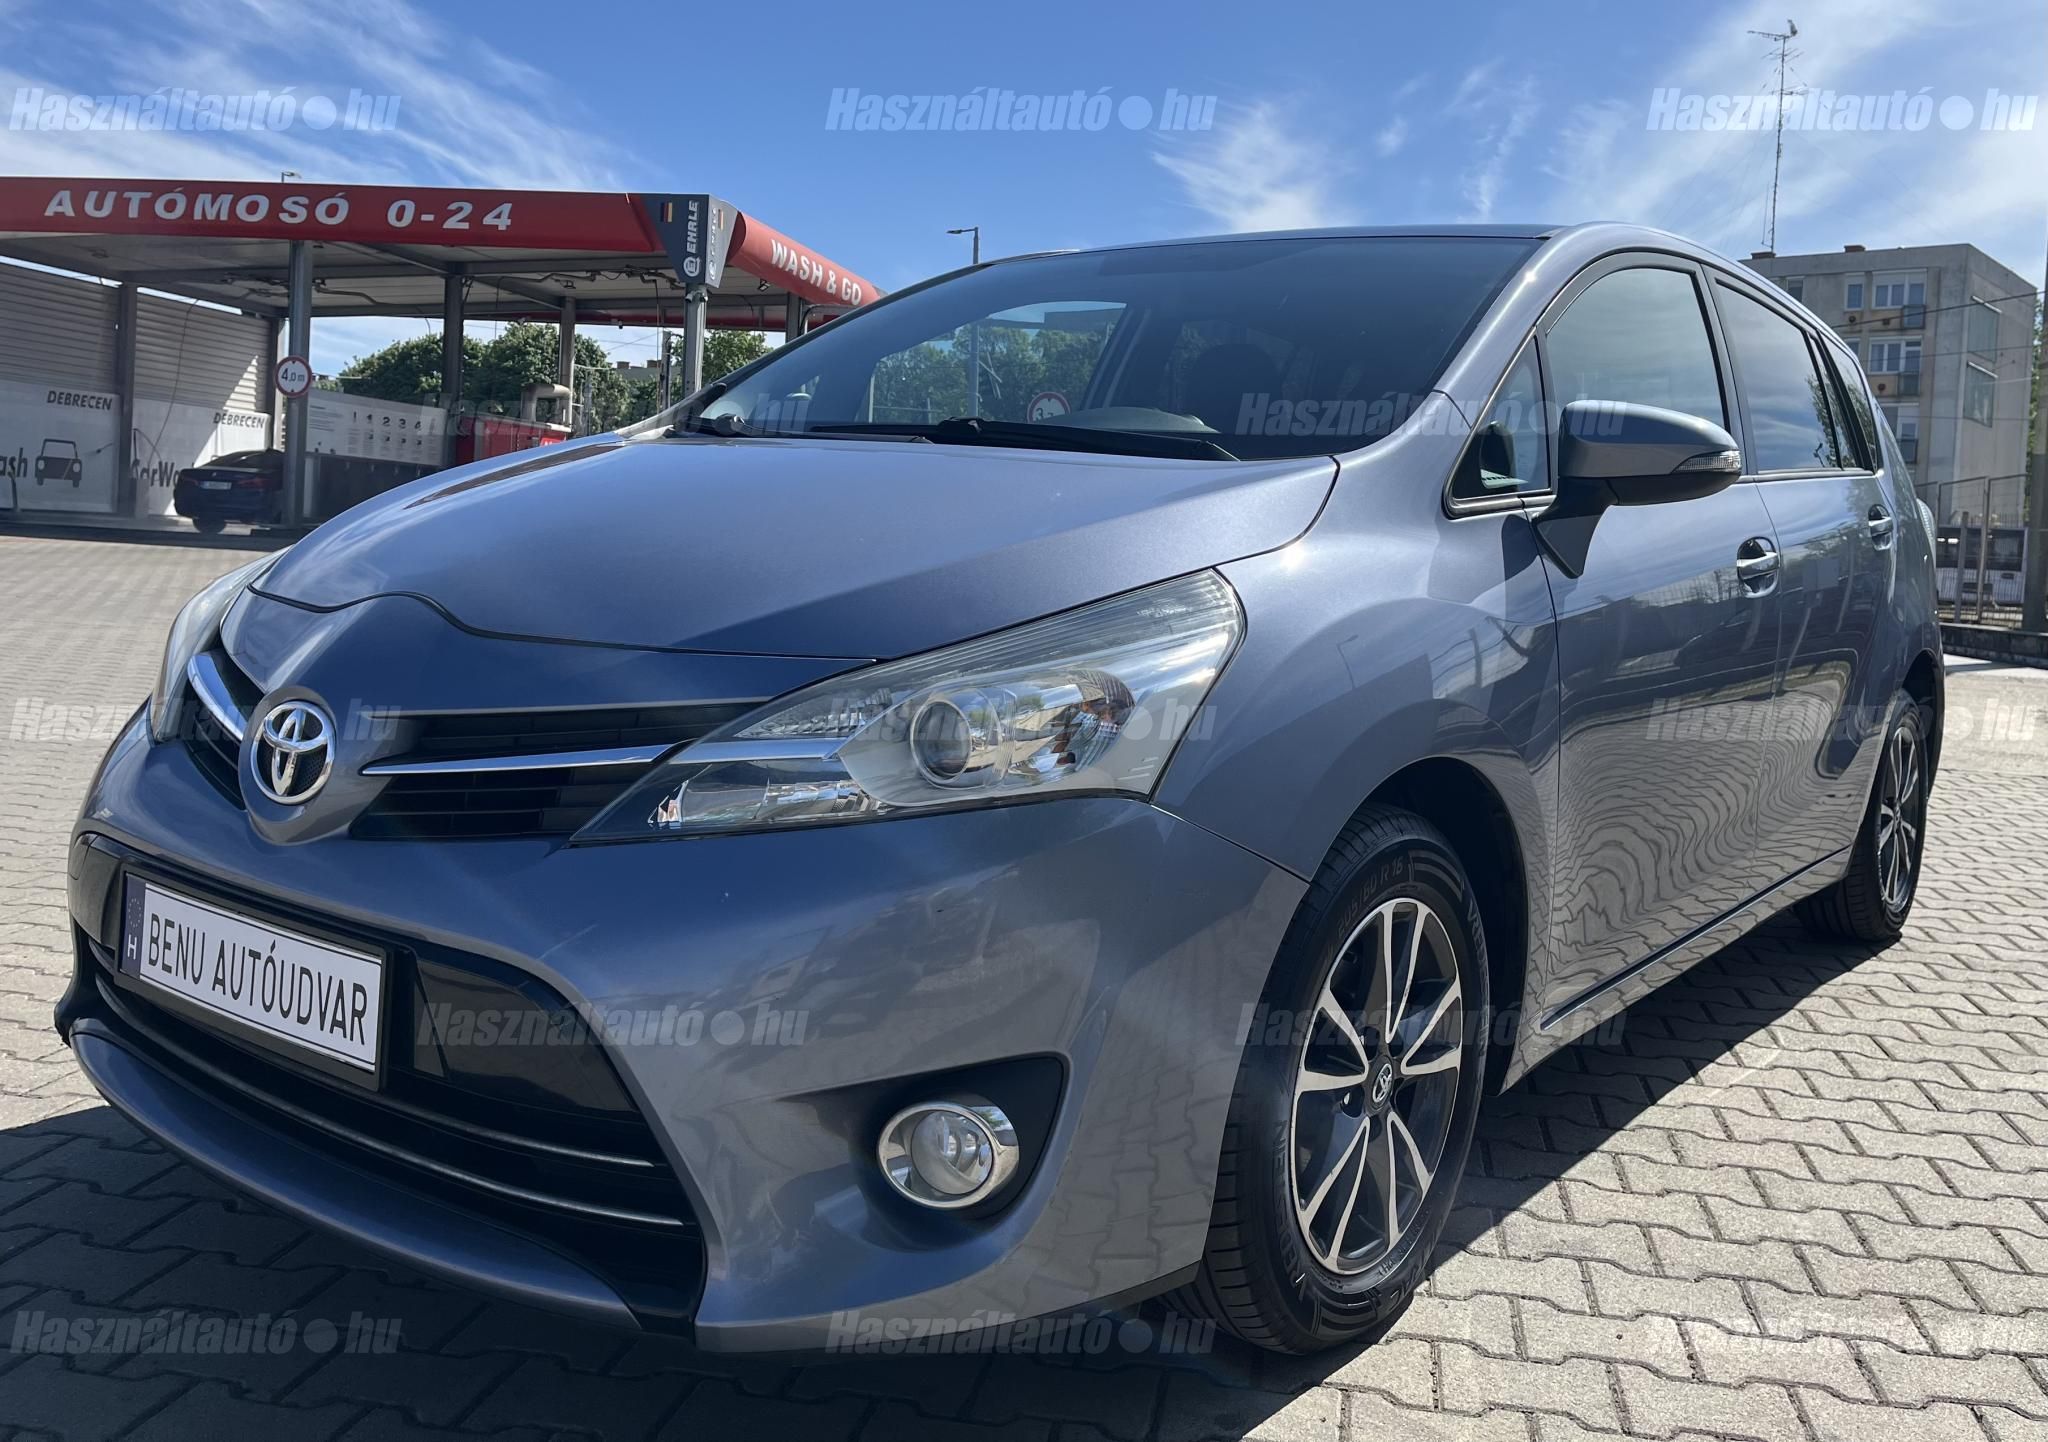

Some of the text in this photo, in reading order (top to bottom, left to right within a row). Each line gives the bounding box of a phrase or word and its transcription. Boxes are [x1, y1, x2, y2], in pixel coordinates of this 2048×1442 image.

[44, 186, 513, 231] AUTÓMOSÓ 0-24
[686, 200, 699, 254] EHRLE
[771, 238, 863, 305] WASH & GO
[46, 390, 113, 411] DEBRECEN
[213, 412, 266, 429] DEBRECEN
[127, 934, 138, 960] H
[148, 912, 368, 1046] BENU AUTÓUDVAR
